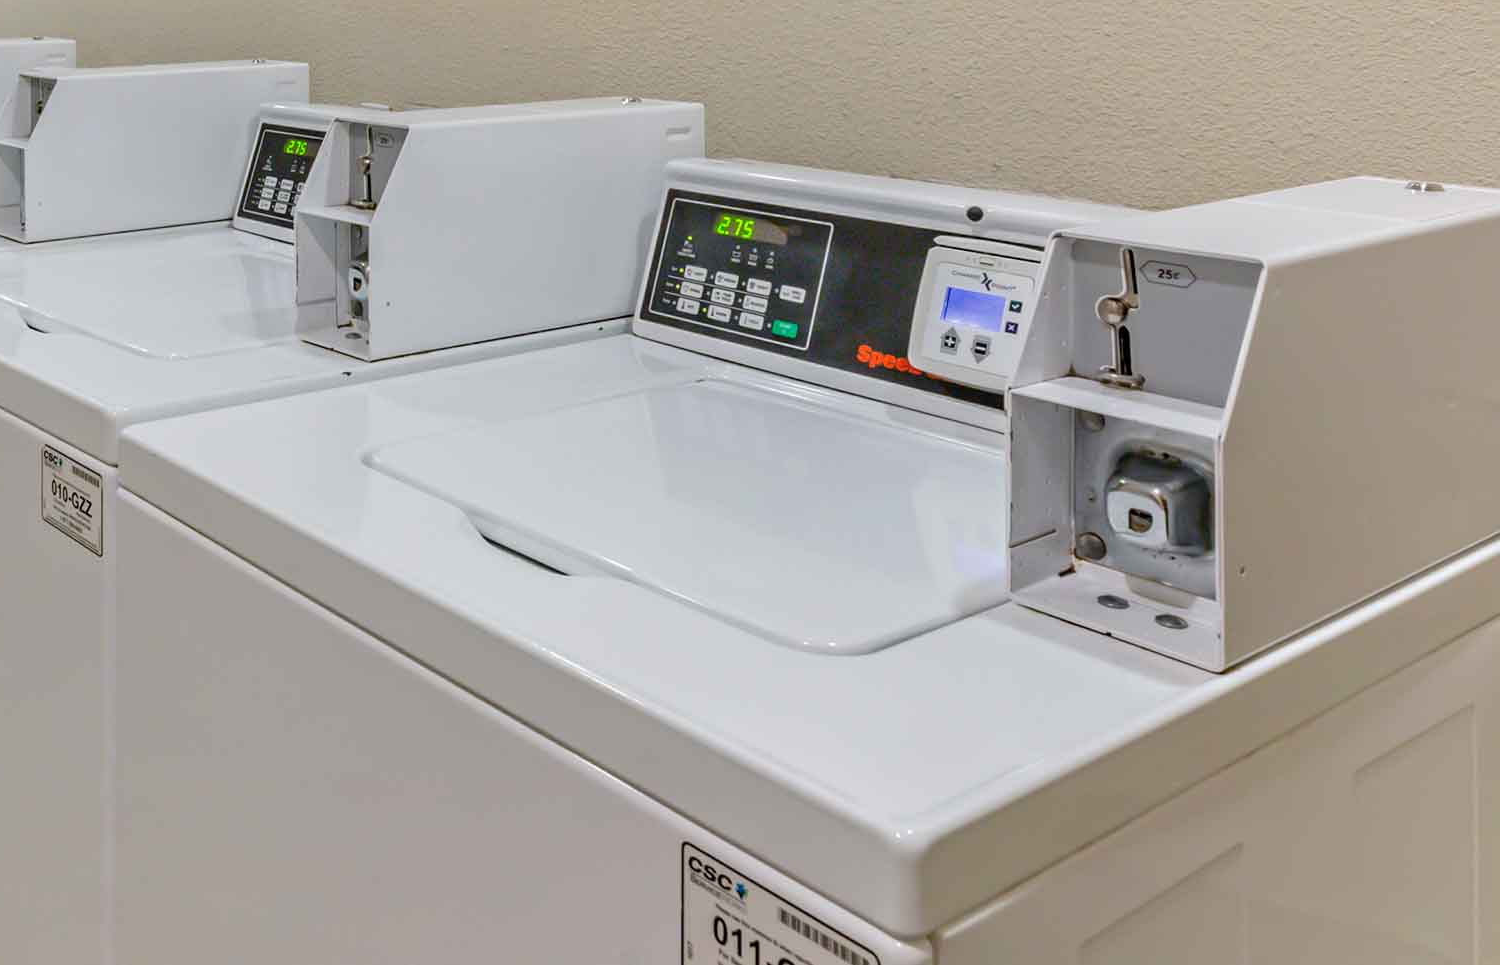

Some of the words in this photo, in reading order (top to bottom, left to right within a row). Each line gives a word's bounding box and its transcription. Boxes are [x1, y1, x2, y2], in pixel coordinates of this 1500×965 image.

[715, 215, 756, 240] 2.75
[51, 479, 93, 518] 010-GZZ
[688, 856, 733, 891] CSC
